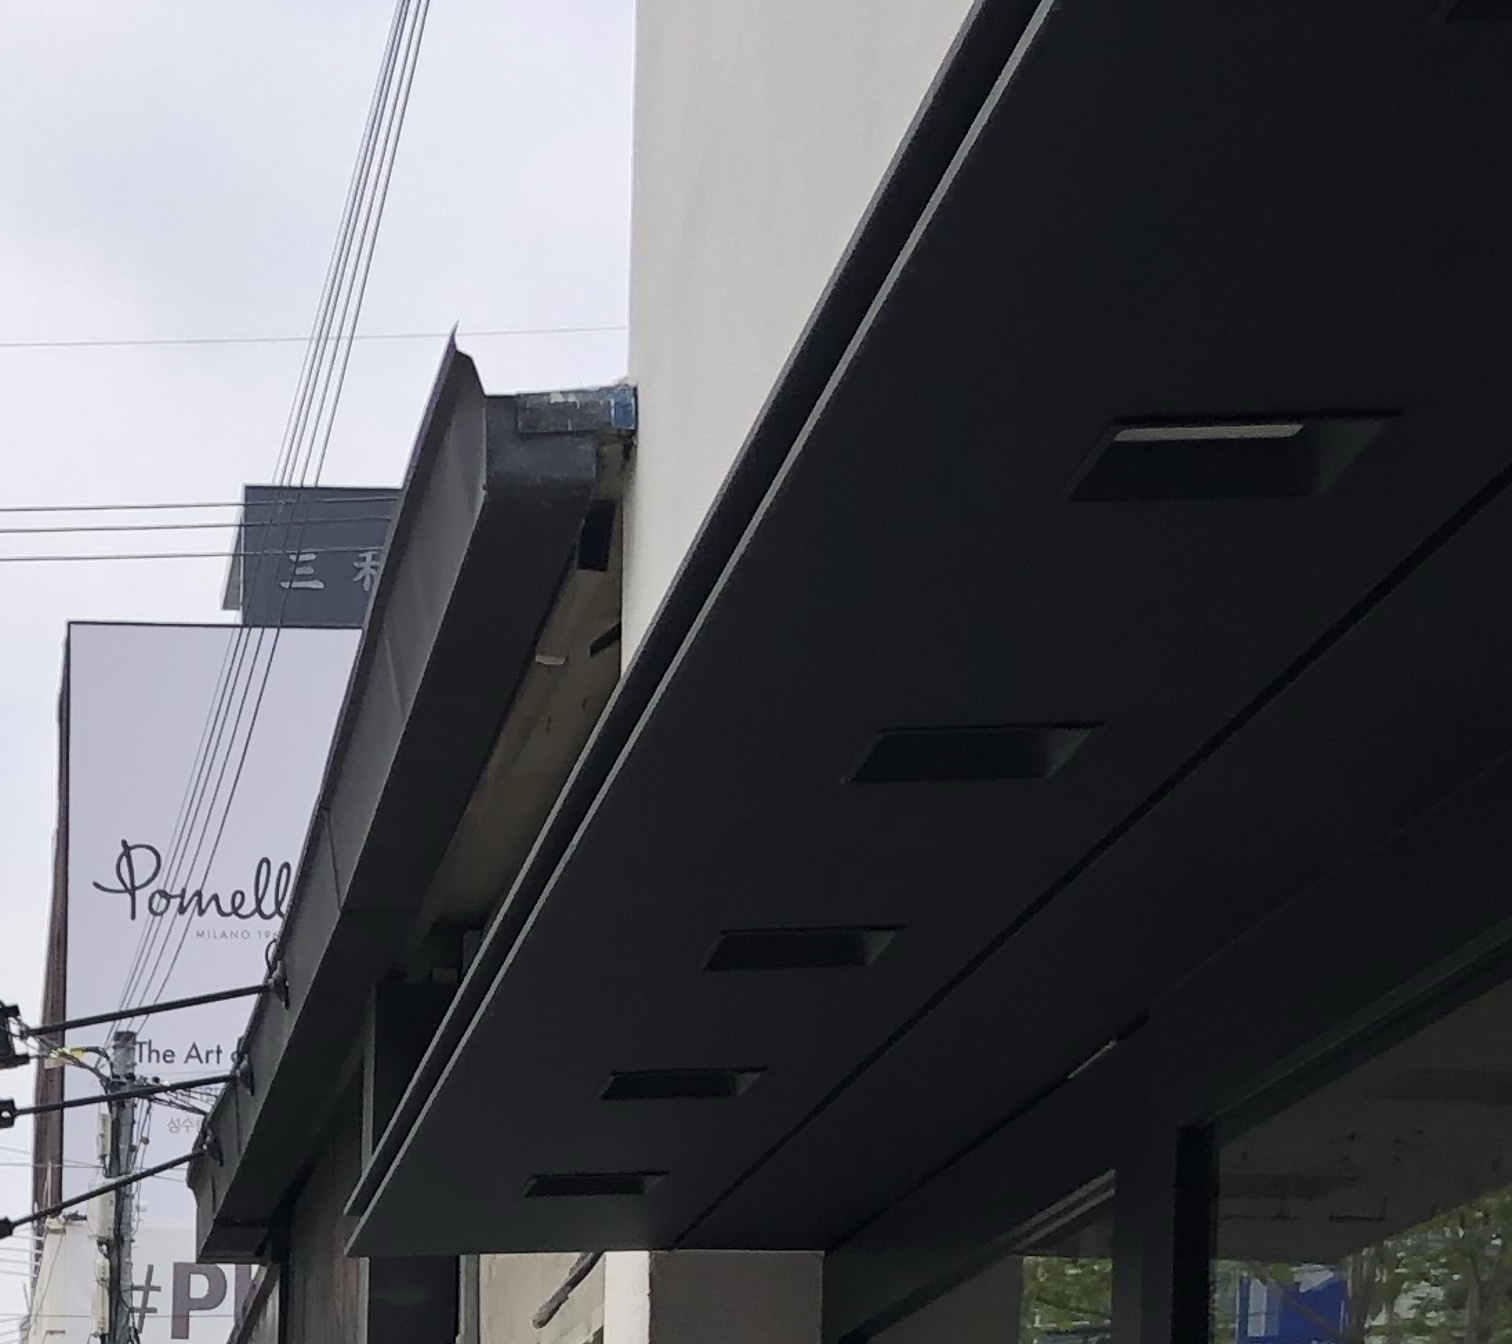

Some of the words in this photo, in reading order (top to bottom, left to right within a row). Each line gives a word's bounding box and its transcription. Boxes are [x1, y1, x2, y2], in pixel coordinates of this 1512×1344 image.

[195, 929, 251, 941] MILANO
[138, 1039, 176, 1064] The
[183, 1042, 223, 1064] Art
[167, 1115, 201, 1134] 성수
